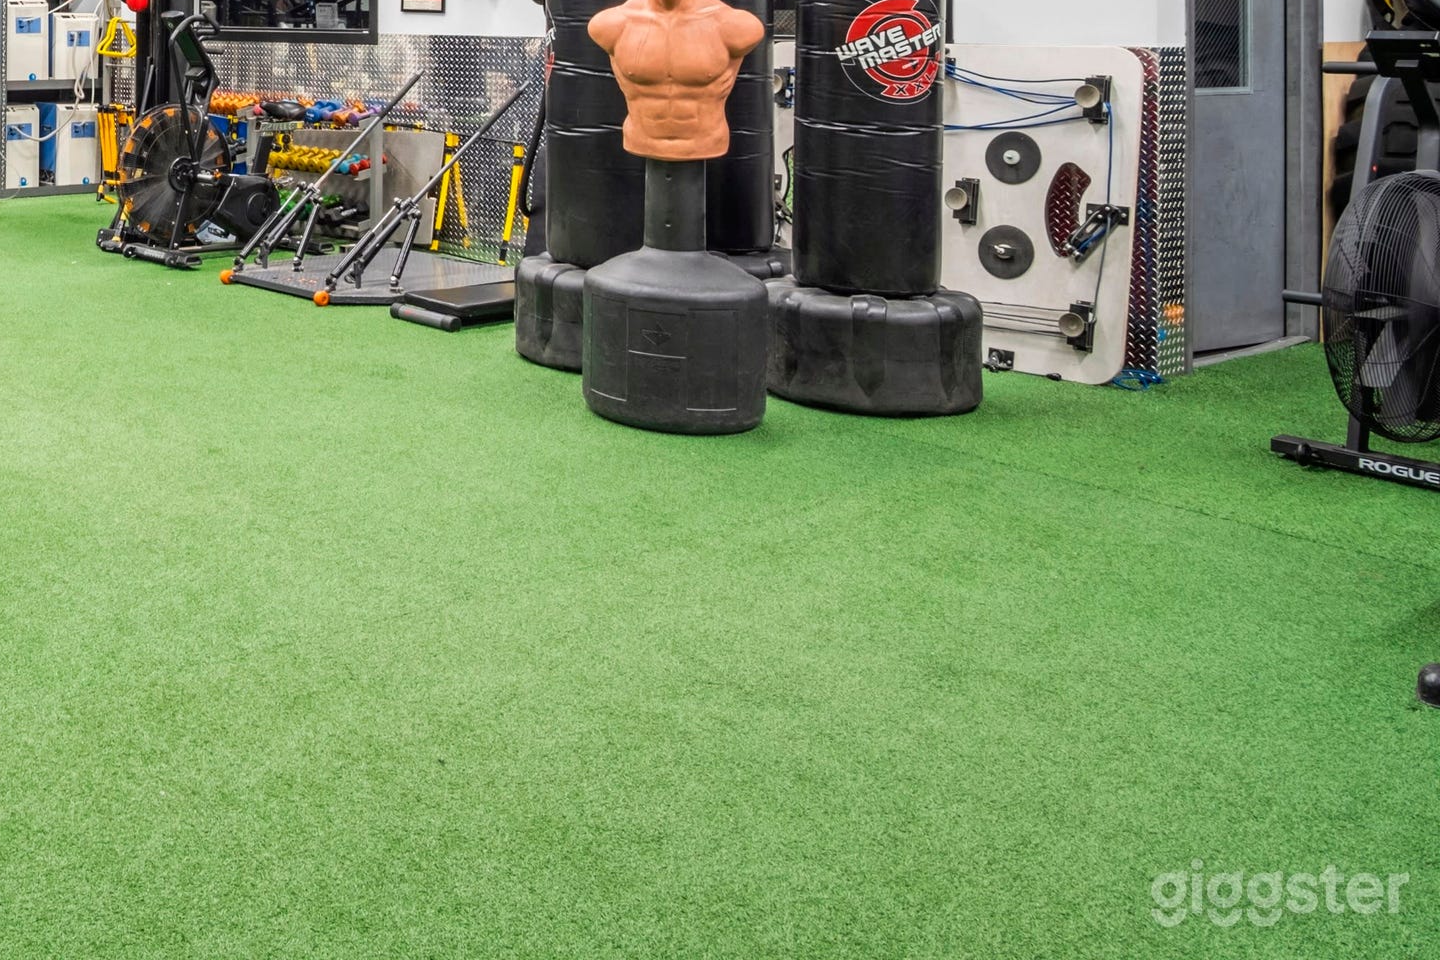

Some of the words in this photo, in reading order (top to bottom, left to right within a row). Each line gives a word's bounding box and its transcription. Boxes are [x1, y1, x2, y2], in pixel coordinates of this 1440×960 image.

[835, 25, 906, 61] WAVE
[858, 22, 941, 70] MASTER
[1358, 457, 1440, 484] ROGUE
